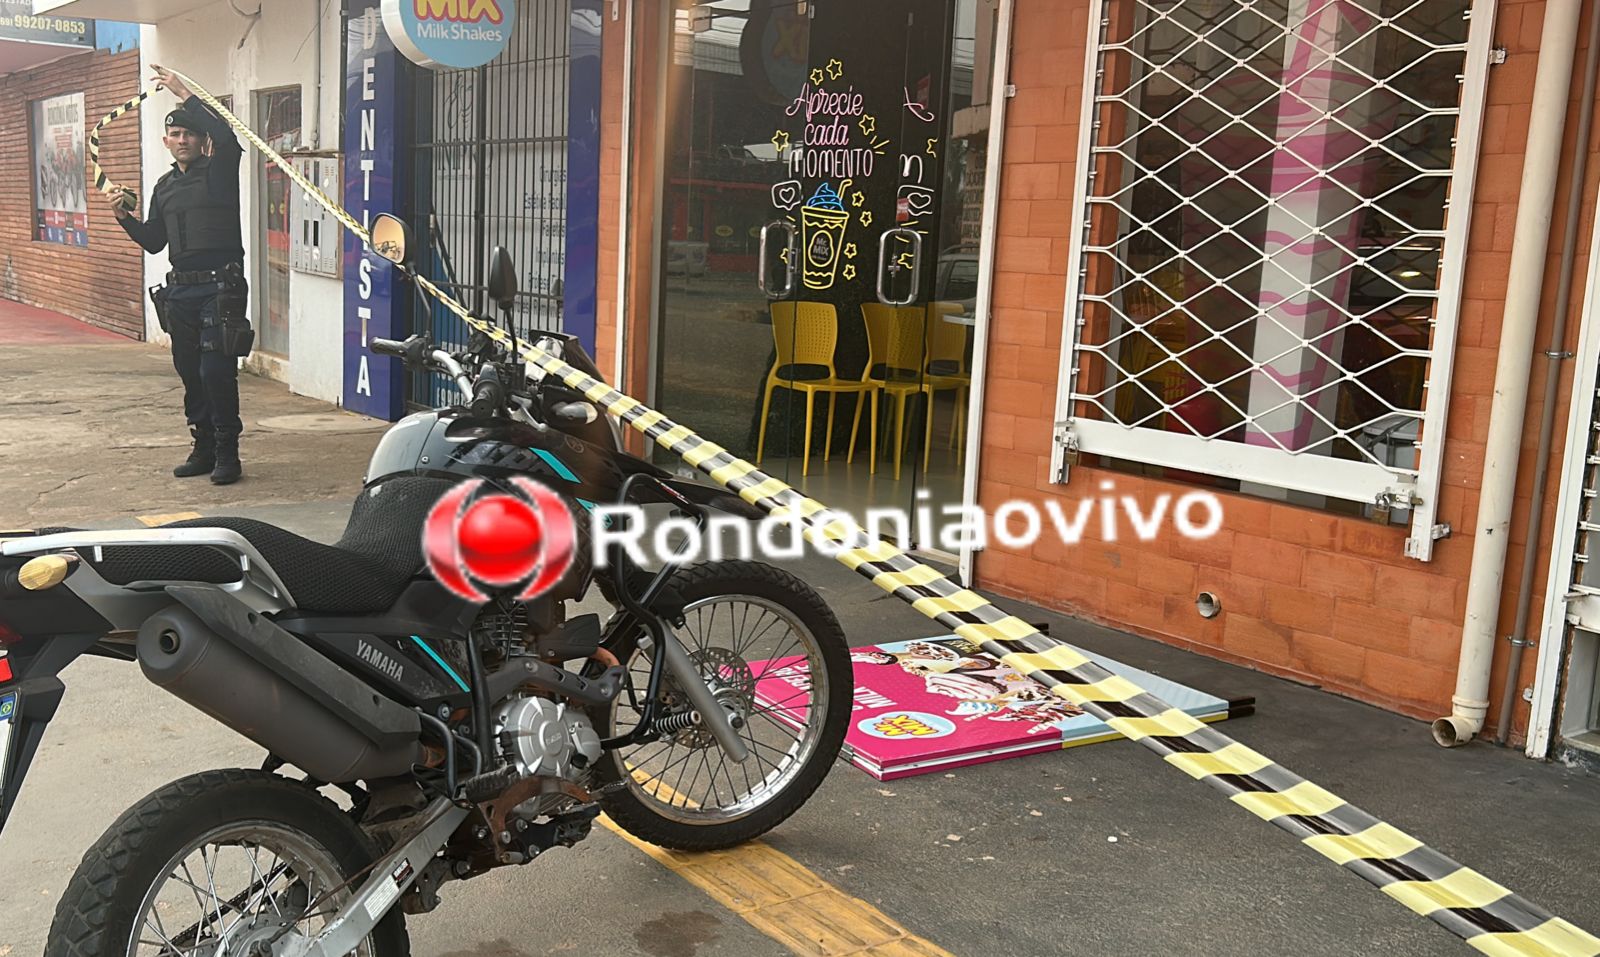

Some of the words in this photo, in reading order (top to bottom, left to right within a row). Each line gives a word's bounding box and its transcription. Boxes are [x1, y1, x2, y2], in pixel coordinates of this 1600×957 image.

[14, 14, 86, 34] 99207-0853
[417, 23, 449, 40] Milk
[450, 24, 503, 42] Shakes
[786, 82, 864, 122] Aprecie
[804, 115, 849, 146] cada
[788, 148, 874, 178] MOMENTO
[356, 7, 375, 397] DENTISTA
[356, 639, 404, 682] YAMAHA
